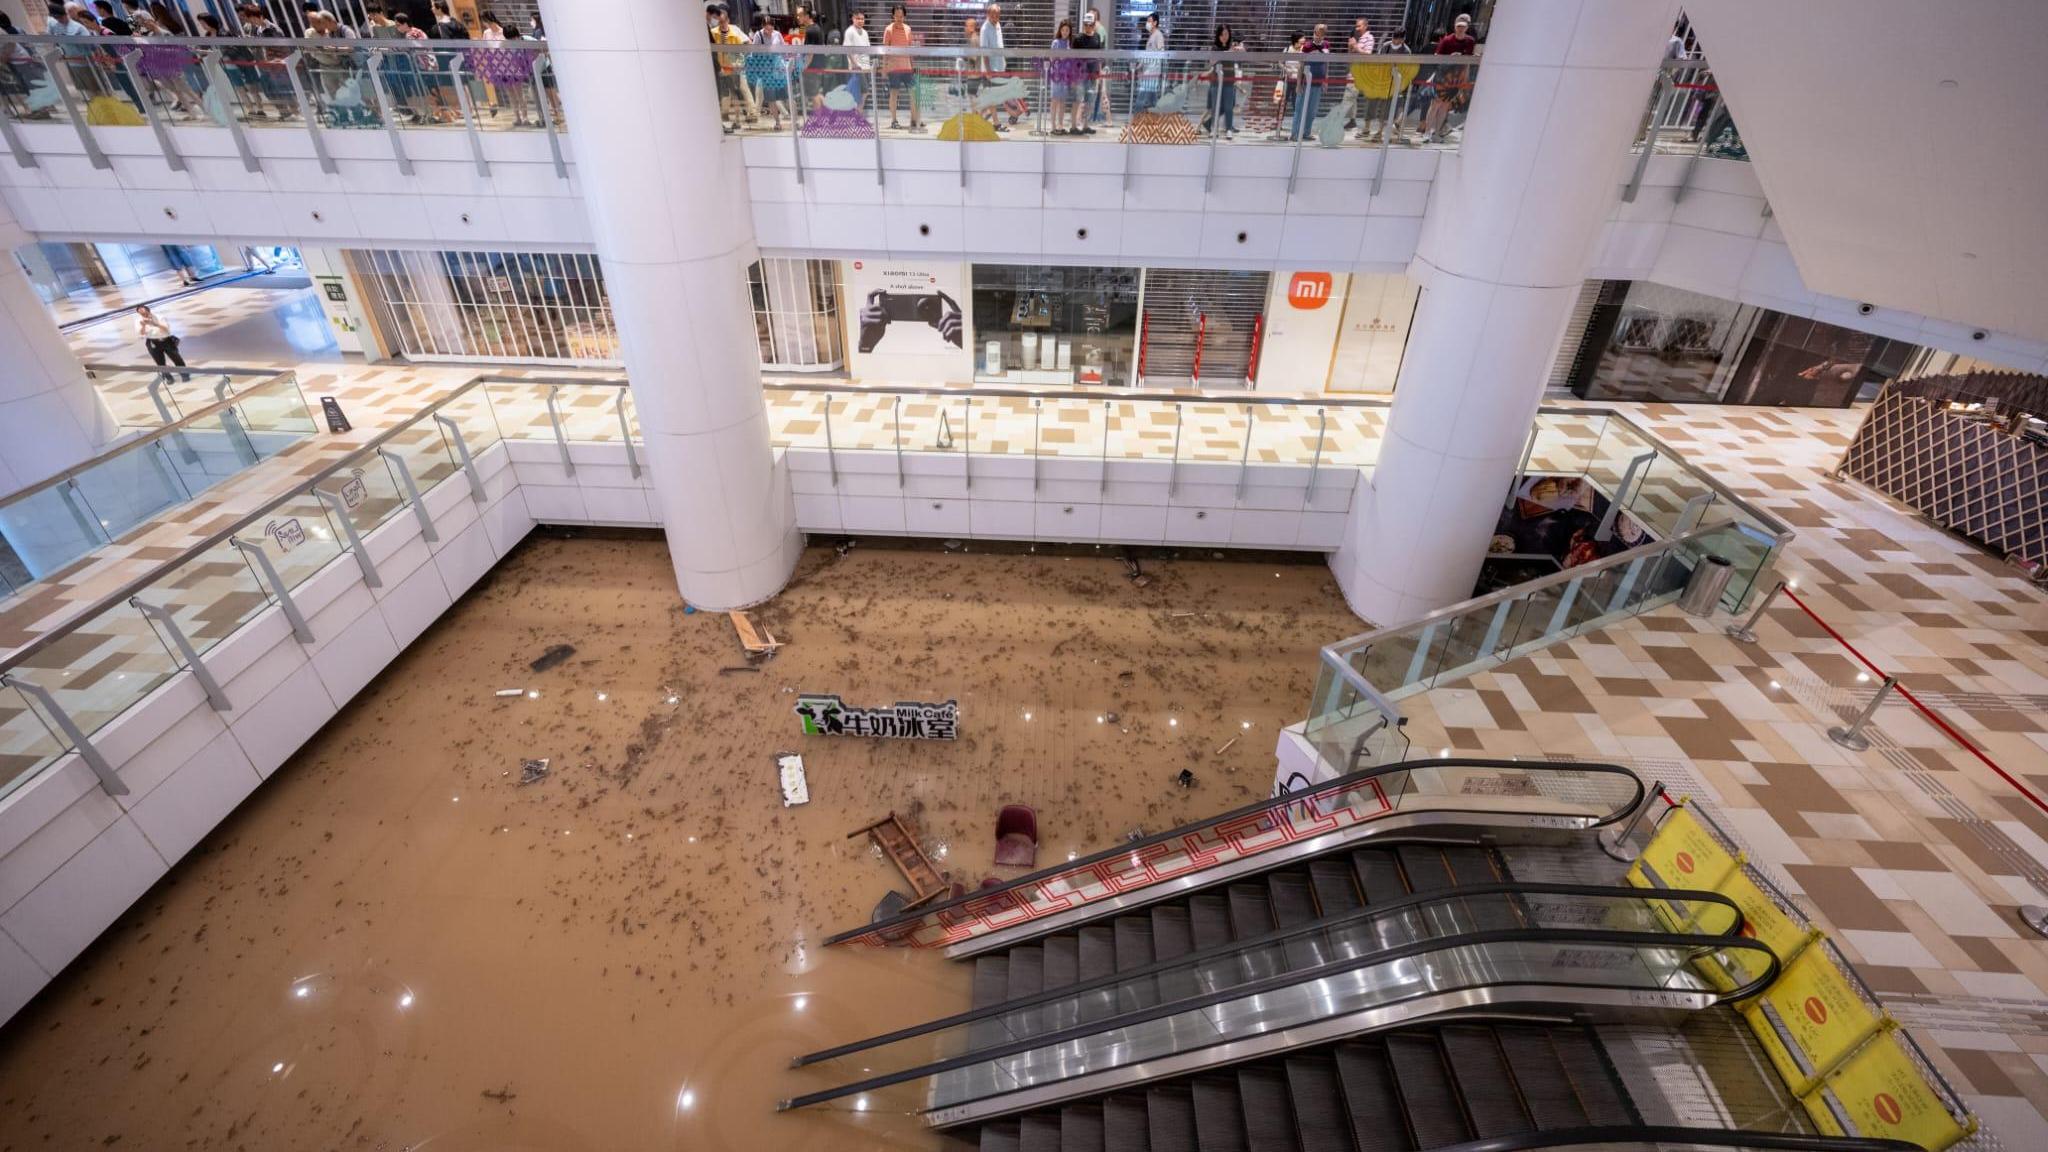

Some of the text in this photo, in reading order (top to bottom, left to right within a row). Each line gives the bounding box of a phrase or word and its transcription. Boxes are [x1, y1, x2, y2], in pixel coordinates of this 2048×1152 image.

[896, 708, 922, 718] Milk
[844, 714, 954, 739] 牛奶冰室
